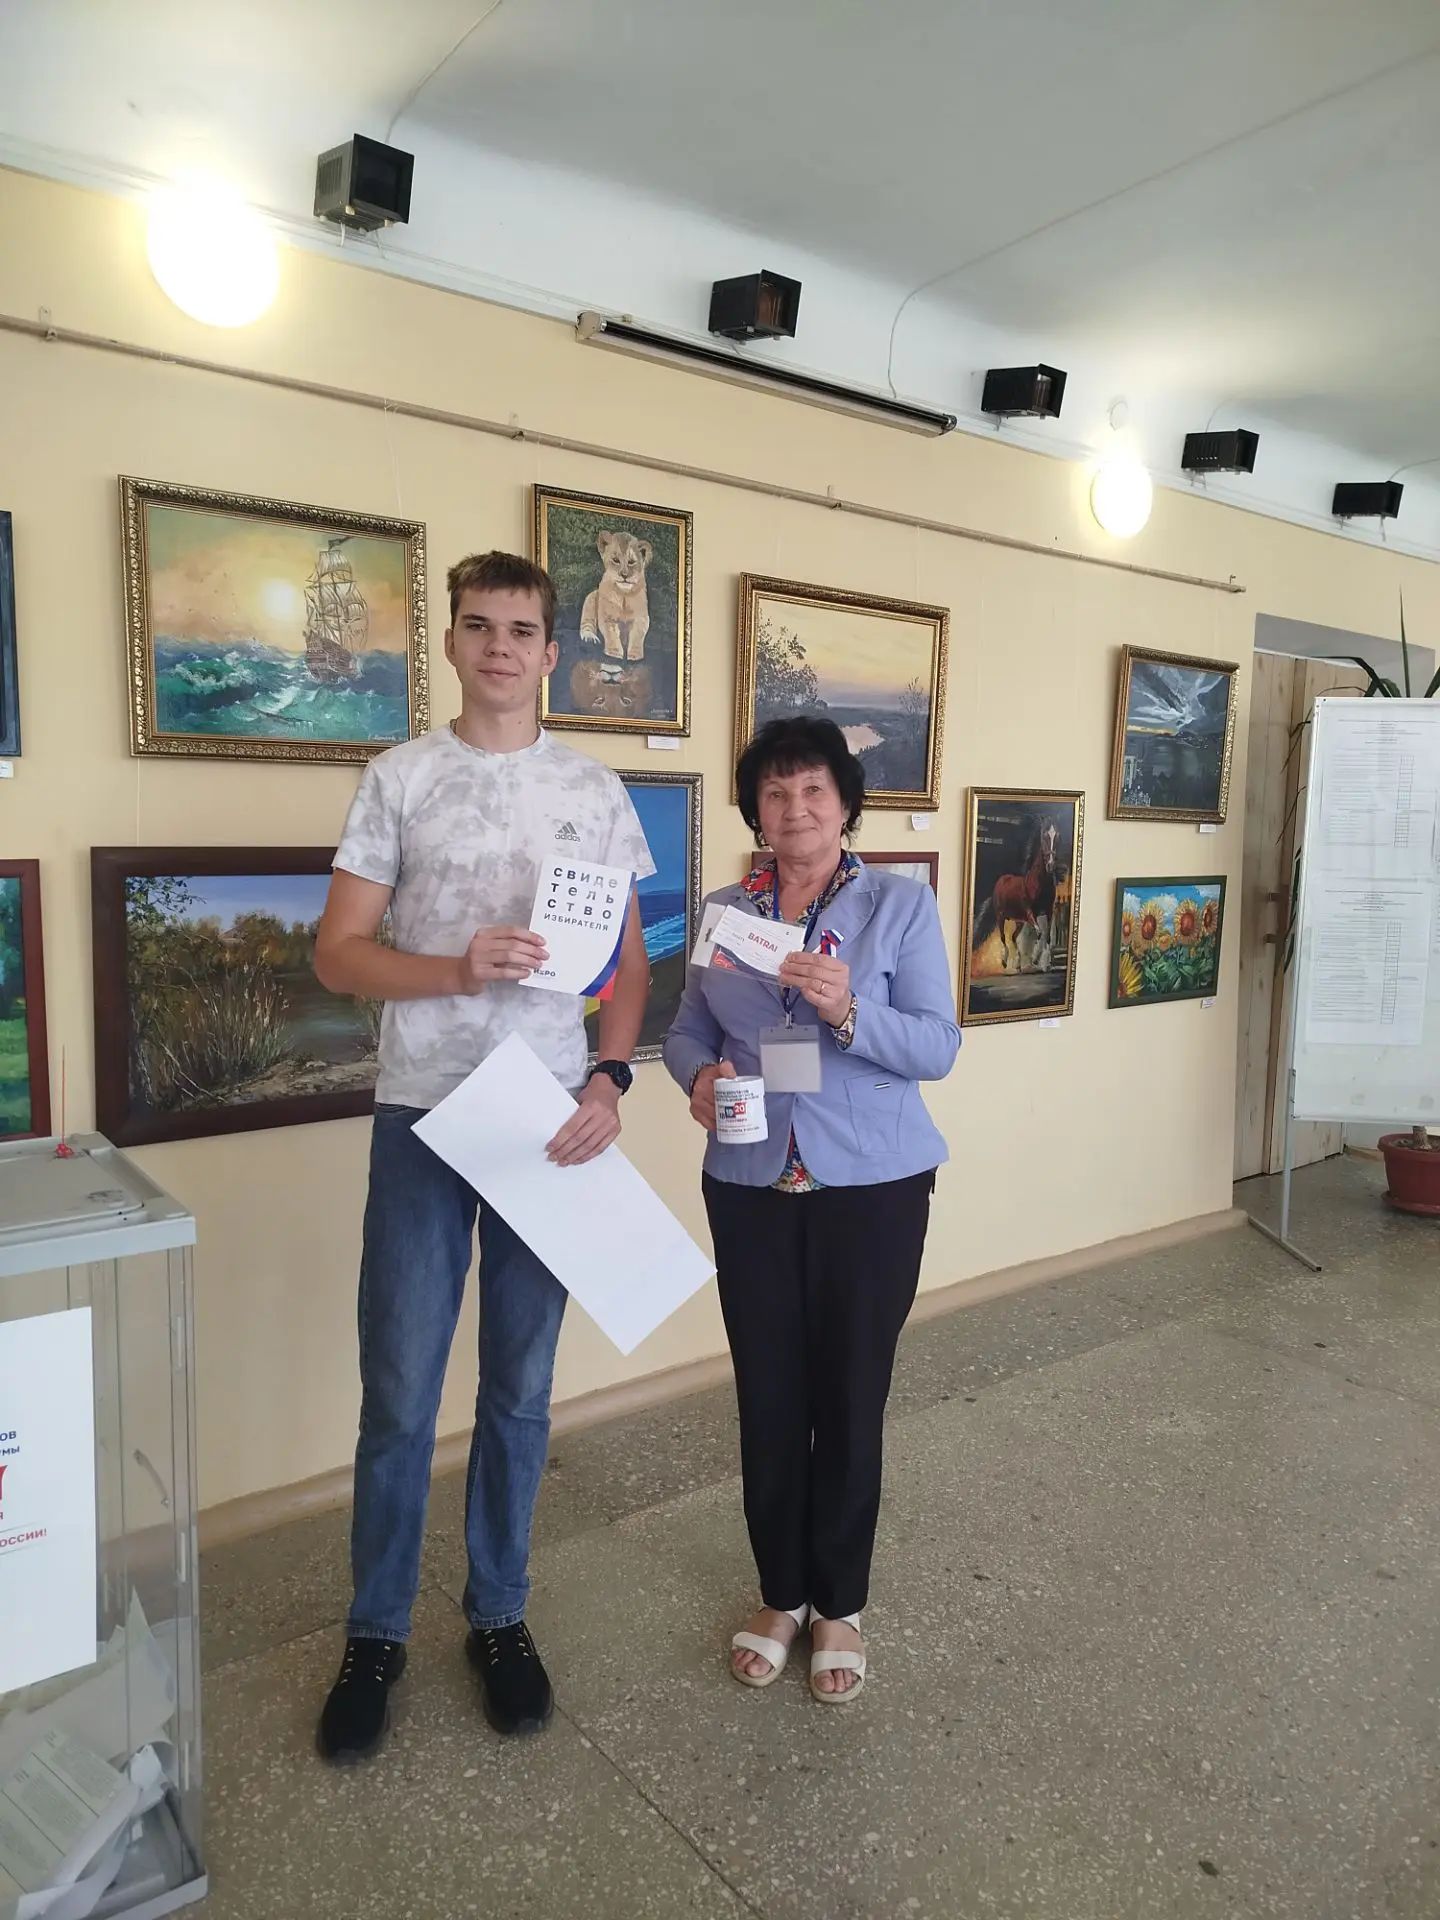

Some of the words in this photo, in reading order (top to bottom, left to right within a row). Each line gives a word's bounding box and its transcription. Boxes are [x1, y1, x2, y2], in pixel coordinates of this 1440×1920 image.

[555, 832, 581, 842] adidas
[544, 913, 609, 931] ИЗБИРАТЕЛЯ
[0, 1445, 20, 1457] МЫ
